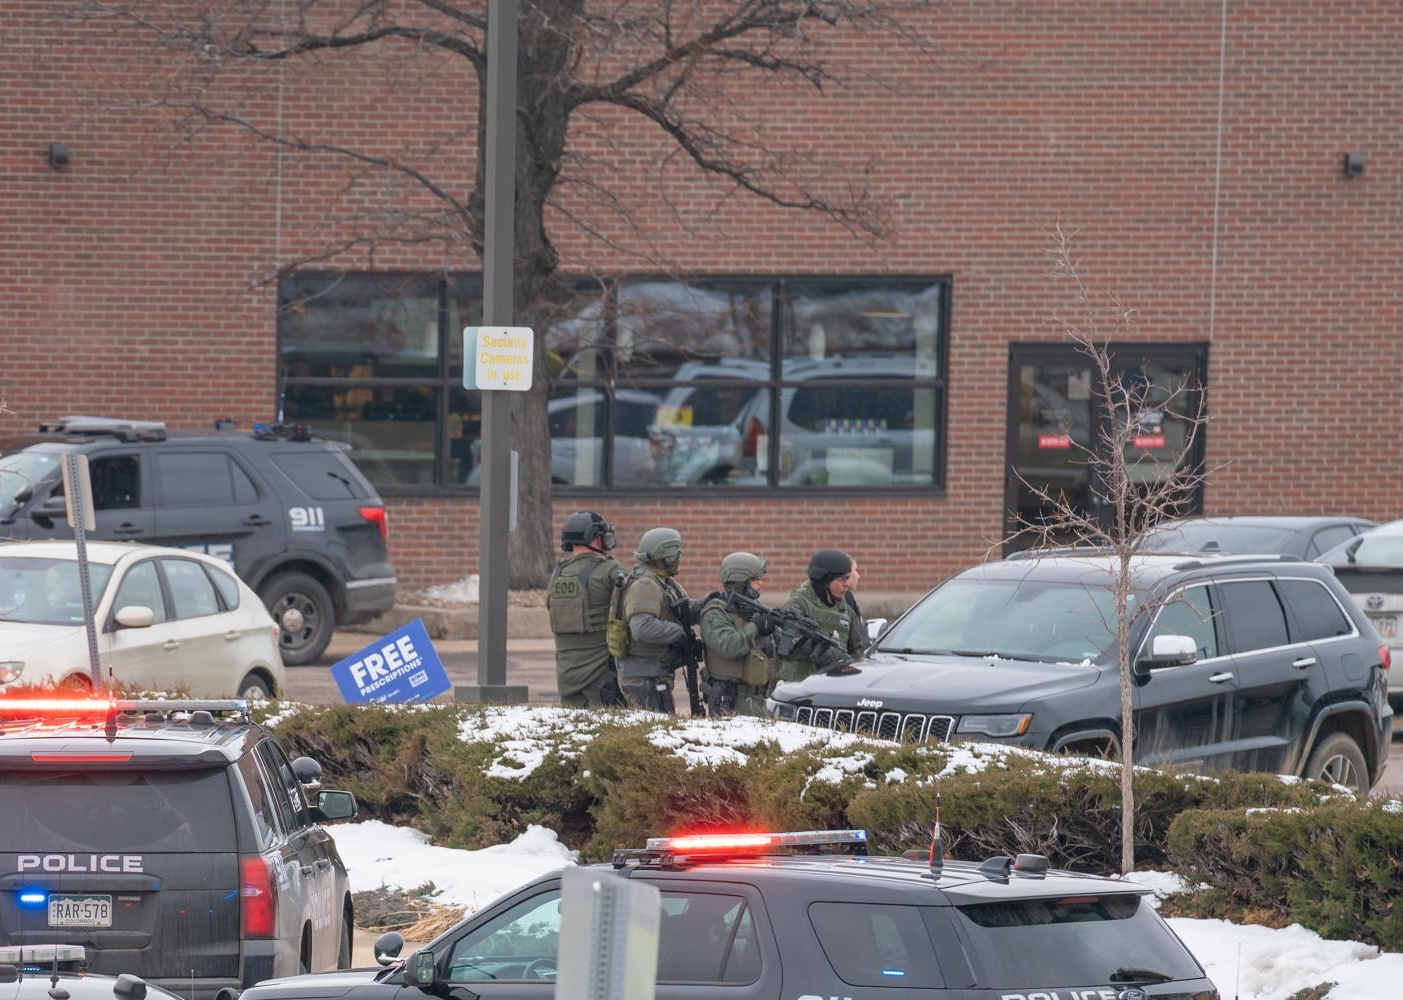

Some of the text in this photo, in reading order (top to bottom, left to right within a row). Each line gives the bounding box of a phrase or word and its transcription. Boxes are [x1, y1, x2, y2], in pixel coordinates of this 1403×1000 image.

[483, 335, 527, 351] Security
[480, 352, 529, 365] Cameras
[487, 368, 522, 381] in use
[289, 507, 324, 526] 911
[555, 581, 576, 594] EOD
[349, 635, 418, 689] FREE
[857, 699, 883, 708] Jeep
[18, 855, 144, 873] POLICE
[1127, 991, 1143, 1000] Ford
